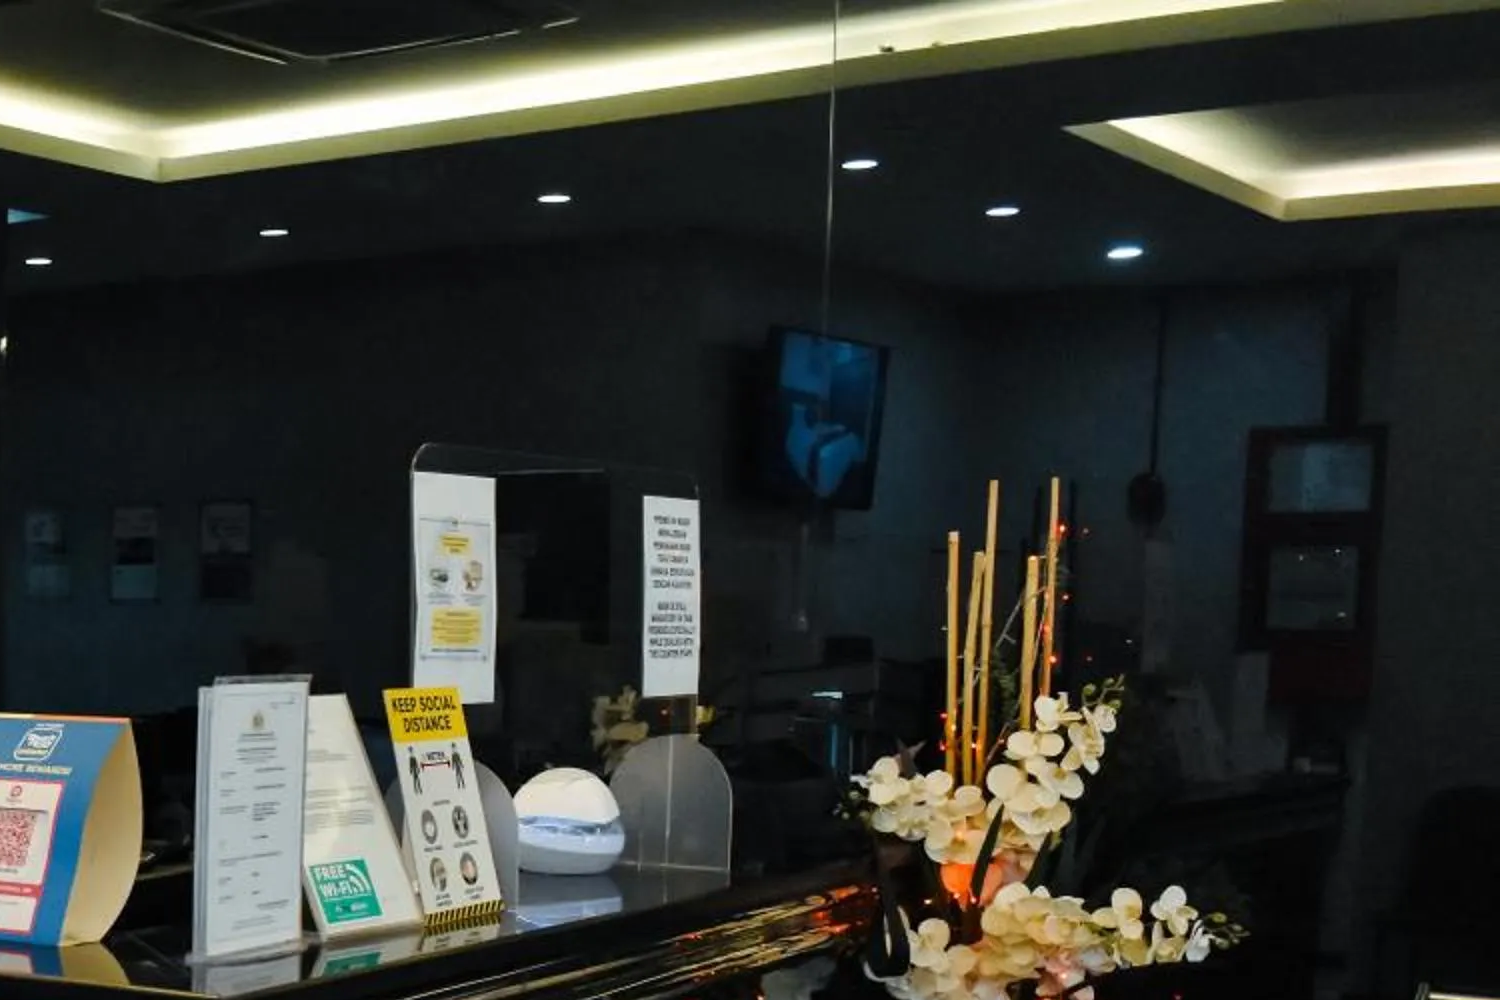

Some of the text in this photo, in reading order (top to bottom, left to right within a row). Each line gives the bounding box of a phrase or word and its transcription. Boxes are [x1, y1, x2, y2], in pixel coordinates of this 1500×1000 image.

[392, 695, 457, 713] KEEP SOCIAL
[403, 715, 453, 733] DISTANCE
[314, 865, 347, 881] FREE
